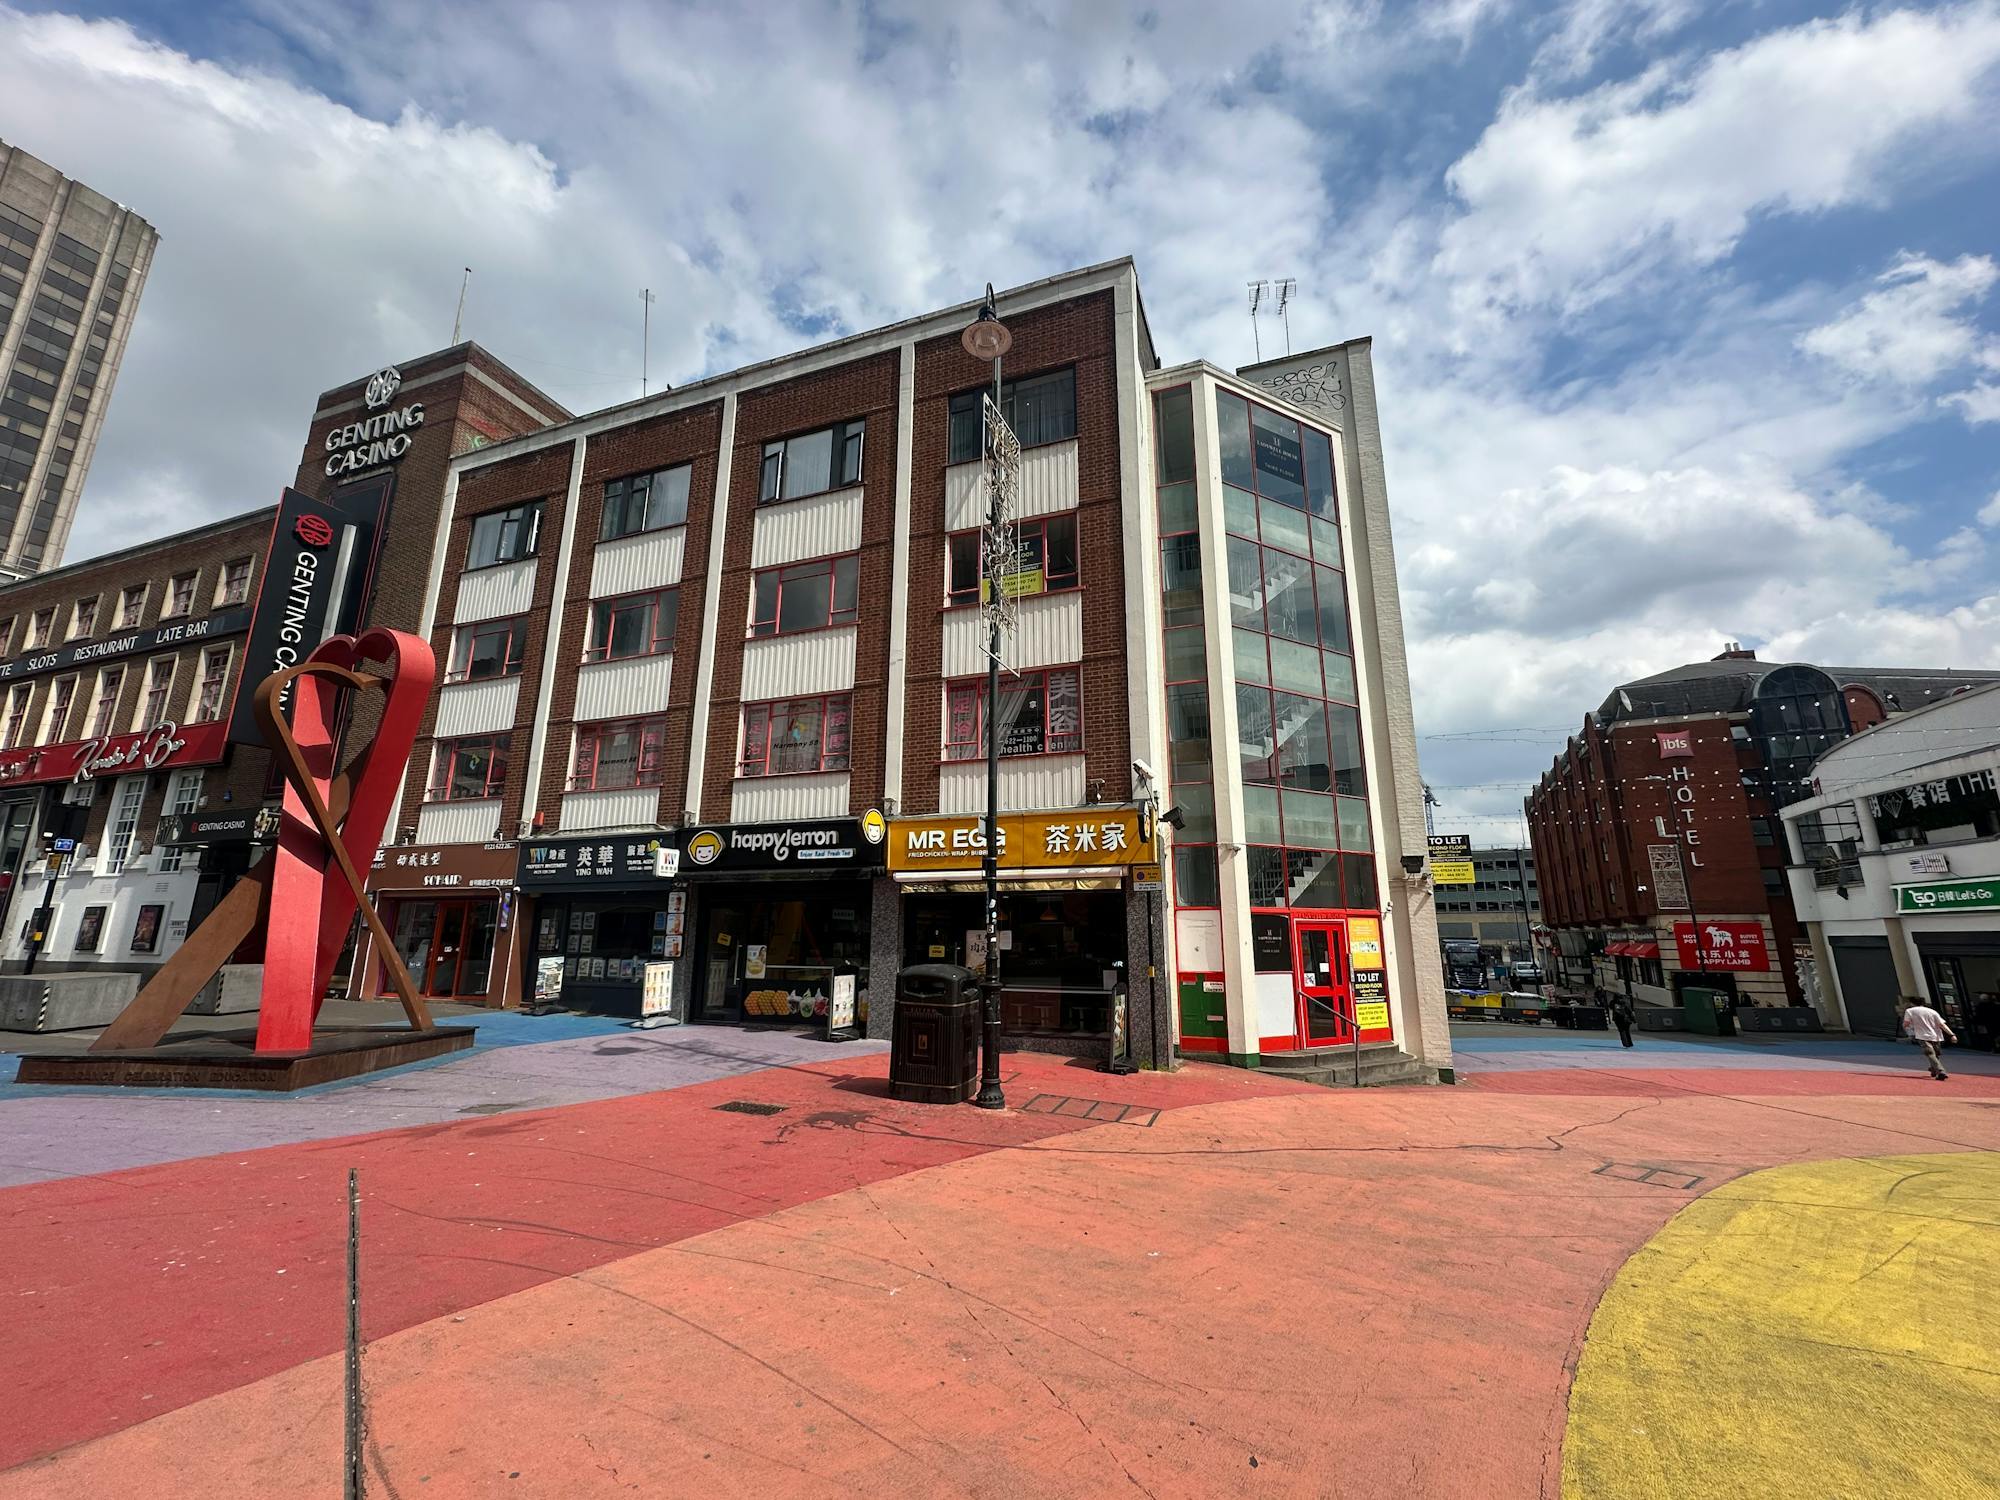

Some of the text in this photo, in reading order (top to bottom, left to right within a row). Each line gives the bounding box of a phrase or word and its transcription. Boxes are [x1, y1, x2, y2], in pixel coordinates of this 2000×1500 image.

[326, 402, 425, 452] GENTING
[325, 434, 412, 477] CASINO
[281, 551, 318, 643] GENTING
[156, 620, 209, 644] LATE BAR
[27, 653, 58, 671] SLOTS
[74, 635, 138, 661] RESTAURANT
[1050, 671, 1078, 733] 美容
[1000, 742, 1033, 754] health
[1663, 739, 1688, 750] ibis
[1905, 780, 1951, 809] 餐馆
[198, 820, 246, 832] GENTING CASINO
[1672, 766, 1704, 866] HOTEL
[908, 827, 1006, 849] MR EGG
[1046, 822, 1127, 853] 茶米家
[1429, 836, 1462, 845] TO LET
[577, 846, 614, 867] 英華
[576, 867, 613, 876] YING WAH
[1955, 890, 1977, 901] Let's
[1977, 888, 1992, 899] Go
[1357, 973, 1379, 982] TO LET
